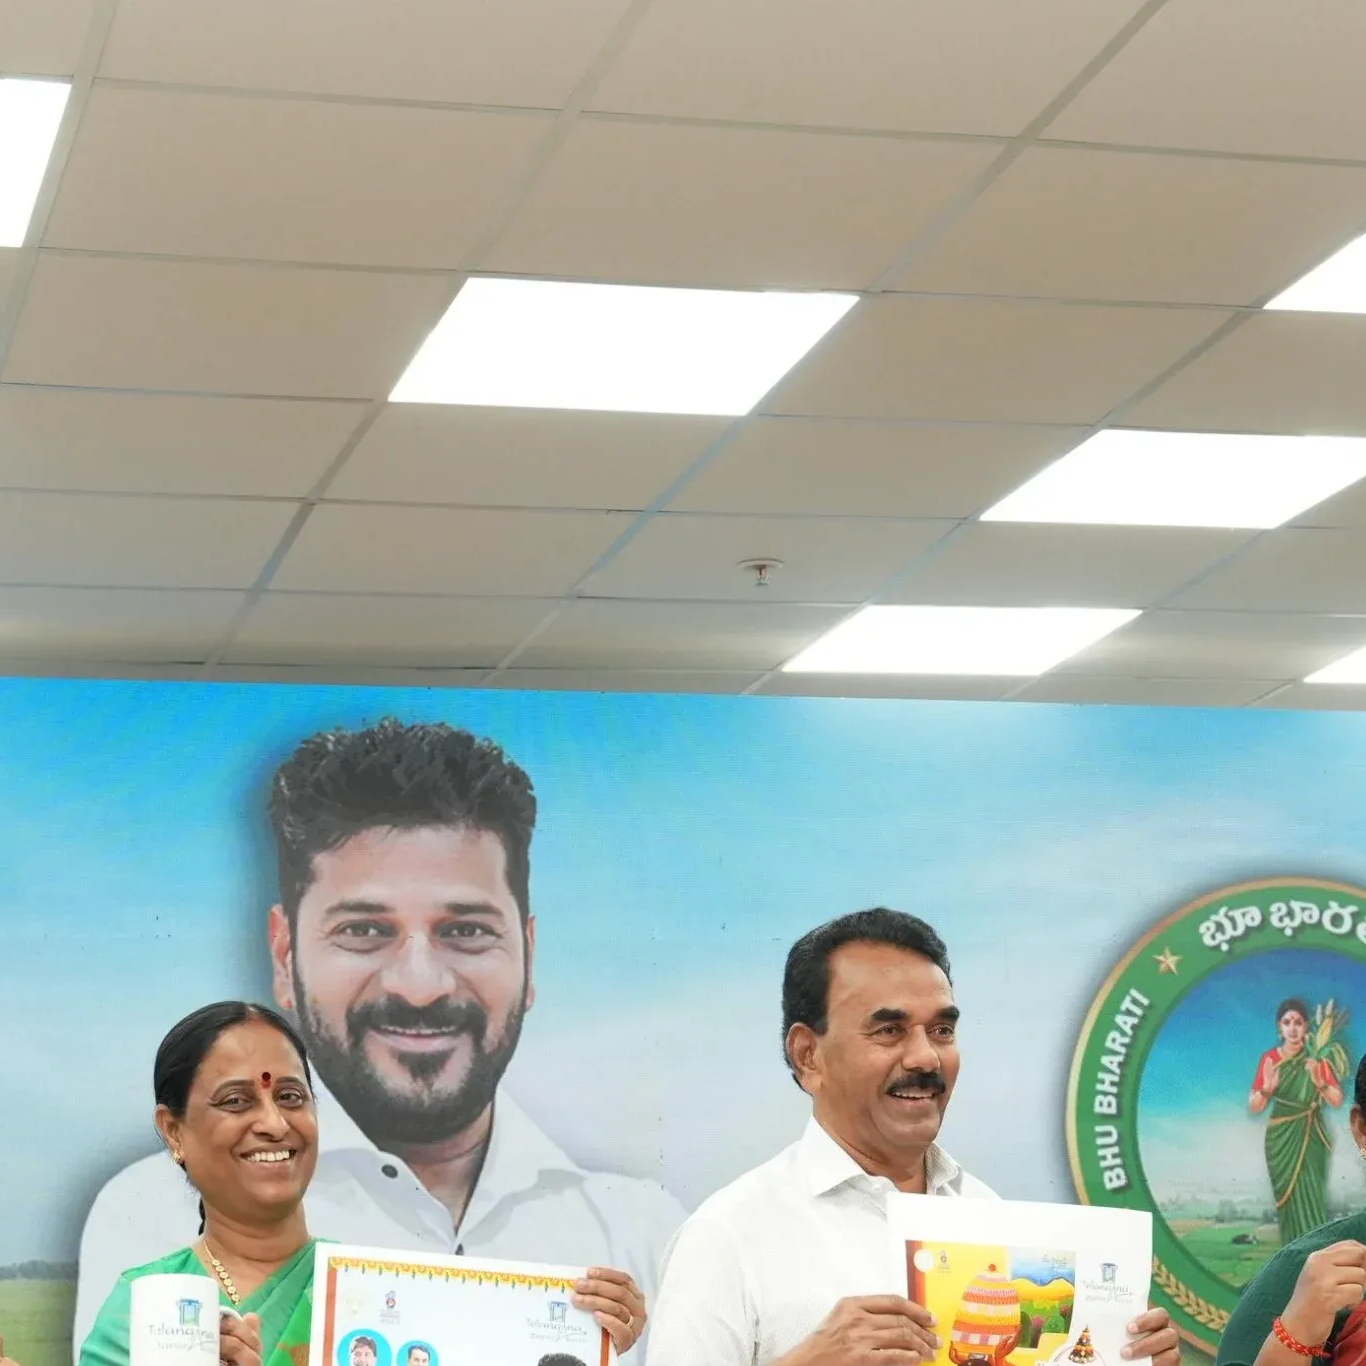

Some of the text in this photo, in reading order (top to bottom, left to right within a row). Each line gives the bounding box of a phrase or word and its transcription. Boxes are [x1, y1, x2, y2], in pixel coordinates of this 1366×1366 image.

[1199, 906, 1262, 952] భూ
[1094, 988, 1151, 1190] BHU BHARATI
